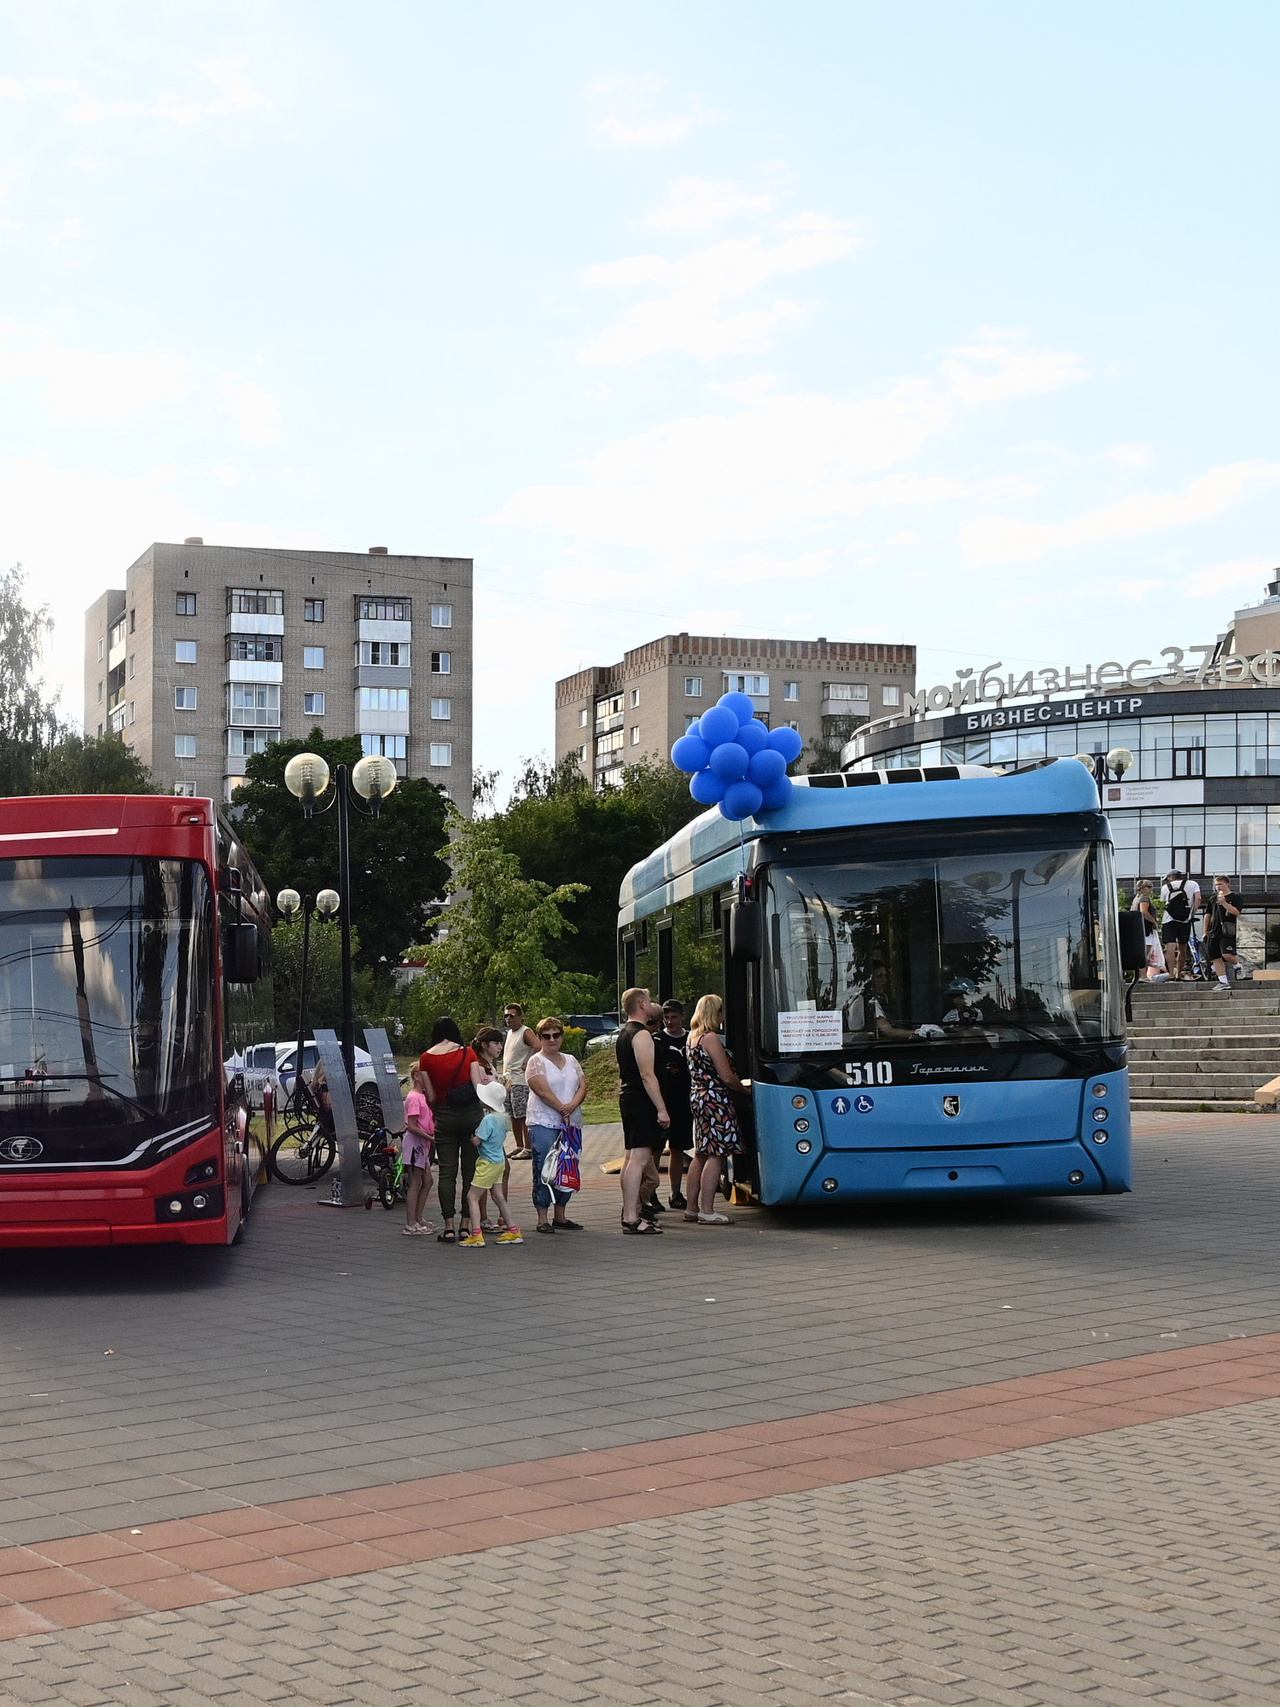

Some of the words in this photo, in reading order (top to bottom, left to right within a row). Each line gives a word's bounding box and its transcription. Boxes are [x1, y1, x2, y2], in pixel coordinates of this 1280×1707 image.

[967, 698, 1143, 731] БИЗНЕС-ЦЕНТР
[845, 1061, 893, 1085] 510
[910, 1063, 988, 1075] Горожанин
